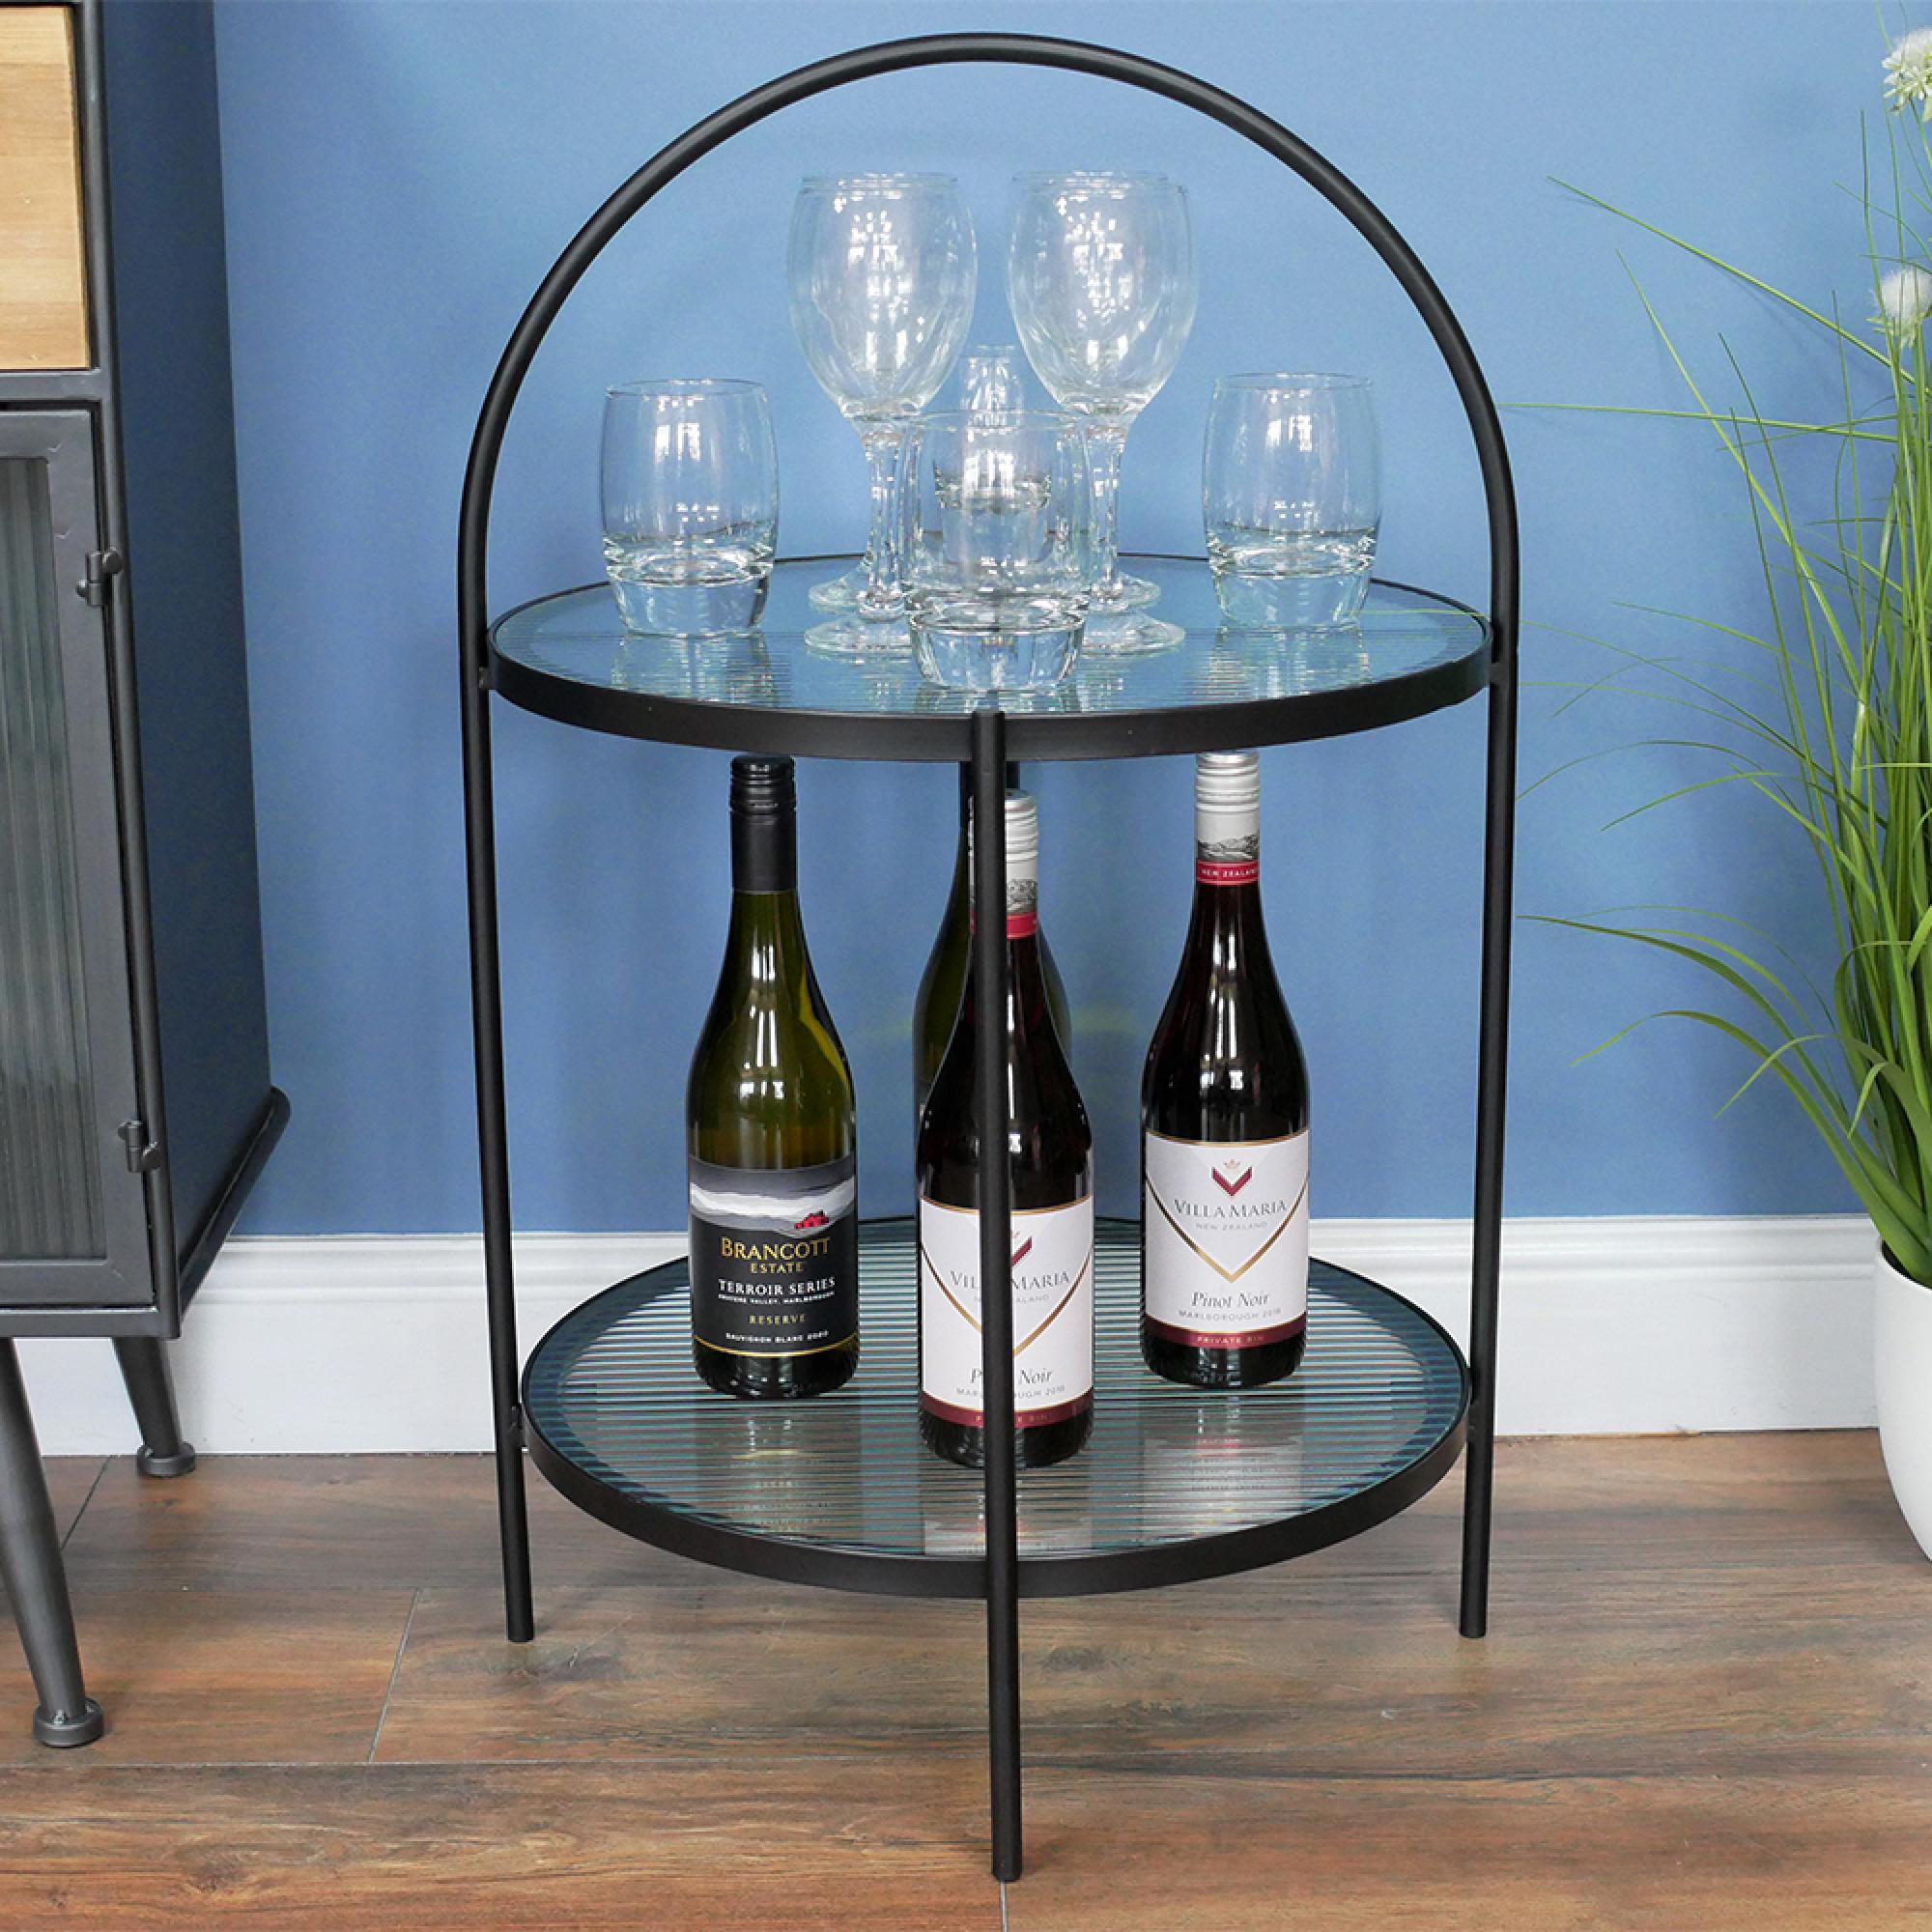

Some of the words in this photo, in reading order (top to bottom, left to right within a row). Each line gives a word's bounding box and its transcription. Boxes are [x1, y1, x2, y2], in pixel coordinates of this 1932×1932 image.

[1175, 1199, 1226, 1218] VILLA
[1229, 1199, 1287, 1218] MARIA
[721, 1236, 830, 1261] BRANCOTT
[751, 1262, 805, 1274] ESTATE
[719, 1278, 783, 1295] TERROIR
[789, 1275, 836, 1294] SERIES
[1191, 1292, 1233, 1308] Pinot
[1237, 1290, 1270, 1307] Noir
[749, 1315, 805, 1326] RESERVE
